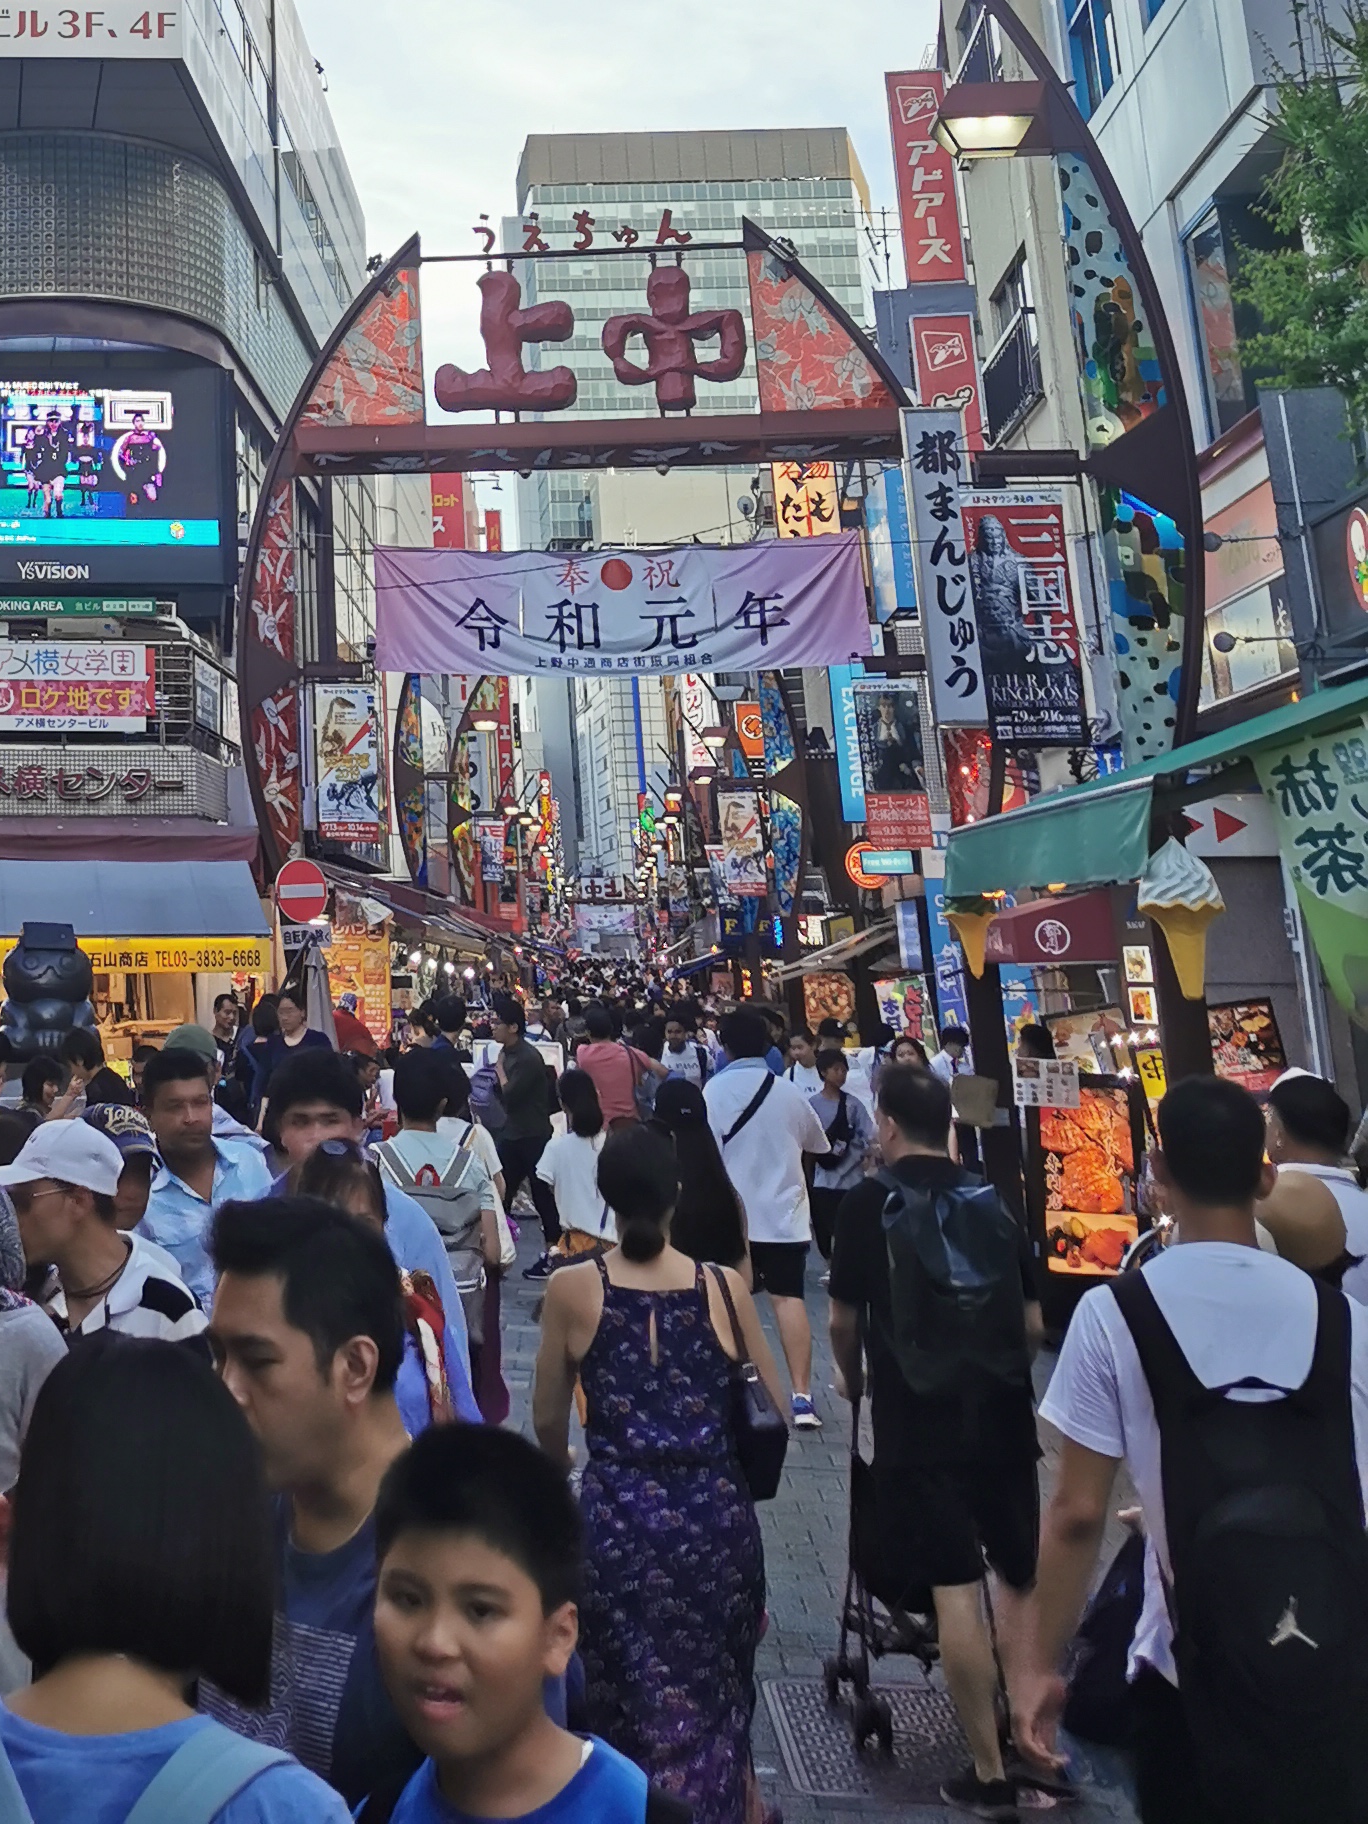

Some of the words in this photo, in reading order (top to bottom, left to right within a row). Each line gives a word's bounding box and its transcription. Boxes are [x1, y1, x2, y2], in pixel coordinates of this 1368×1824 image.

[434, 265, 748, 413] 上中
[432, 494, 460, 507] ロット
[913, 429, 979, 699] 都まんじゅう
[32, 601, 64, 612] AREA
[1008, 513, 1078, 665] 三国志
[455, 590, 792, 654] 令和元年
[20, 686, 136, 710] ロケ地です
[14, 717, 109, 729] アメ横センタービル
[840, 686, 865, 798] EXCHANGE
[90, 952, 149, 968] 石山商店
[155, 950, 262, 968] TEL03-3833-6668
